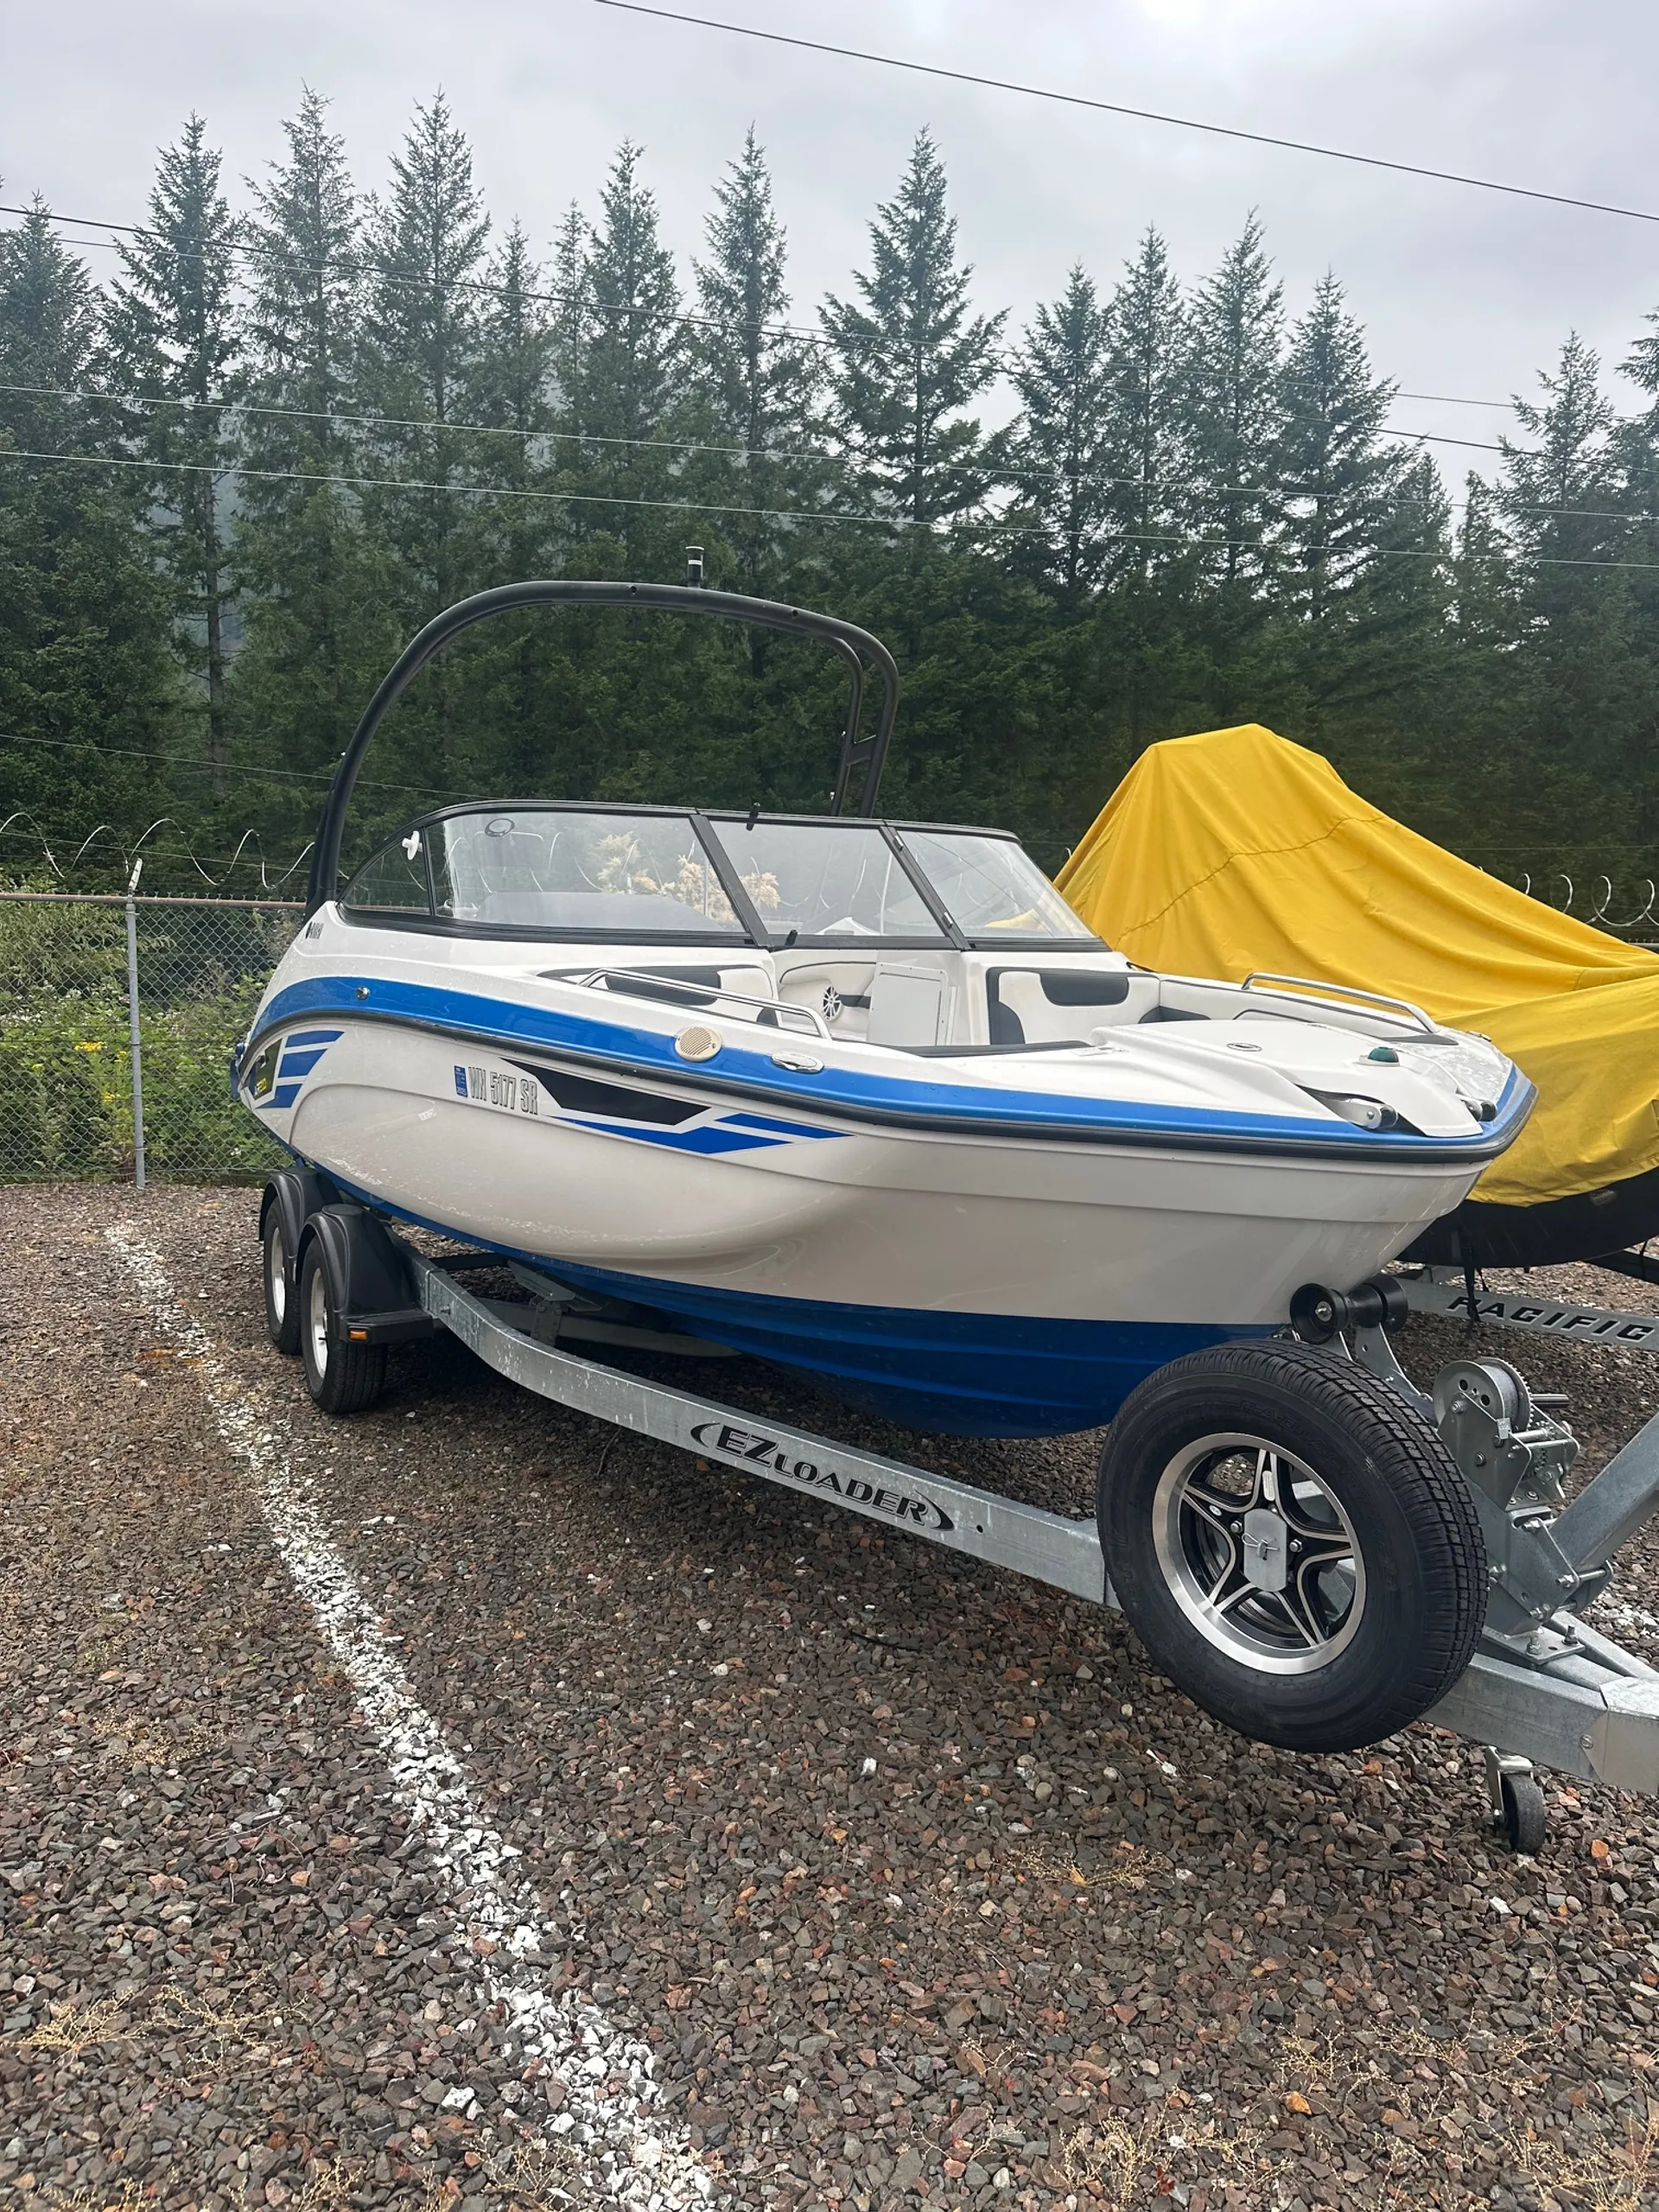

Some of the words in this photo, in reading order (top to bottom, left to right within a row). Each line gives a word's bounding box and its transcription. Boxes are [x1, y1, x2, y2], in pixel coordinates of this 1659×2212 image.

[489, 1071, 518, 1109] 5177
[520, 1078, 538, 1116] SR
[1446, 1296, 1656, 1343] PACIFIC
